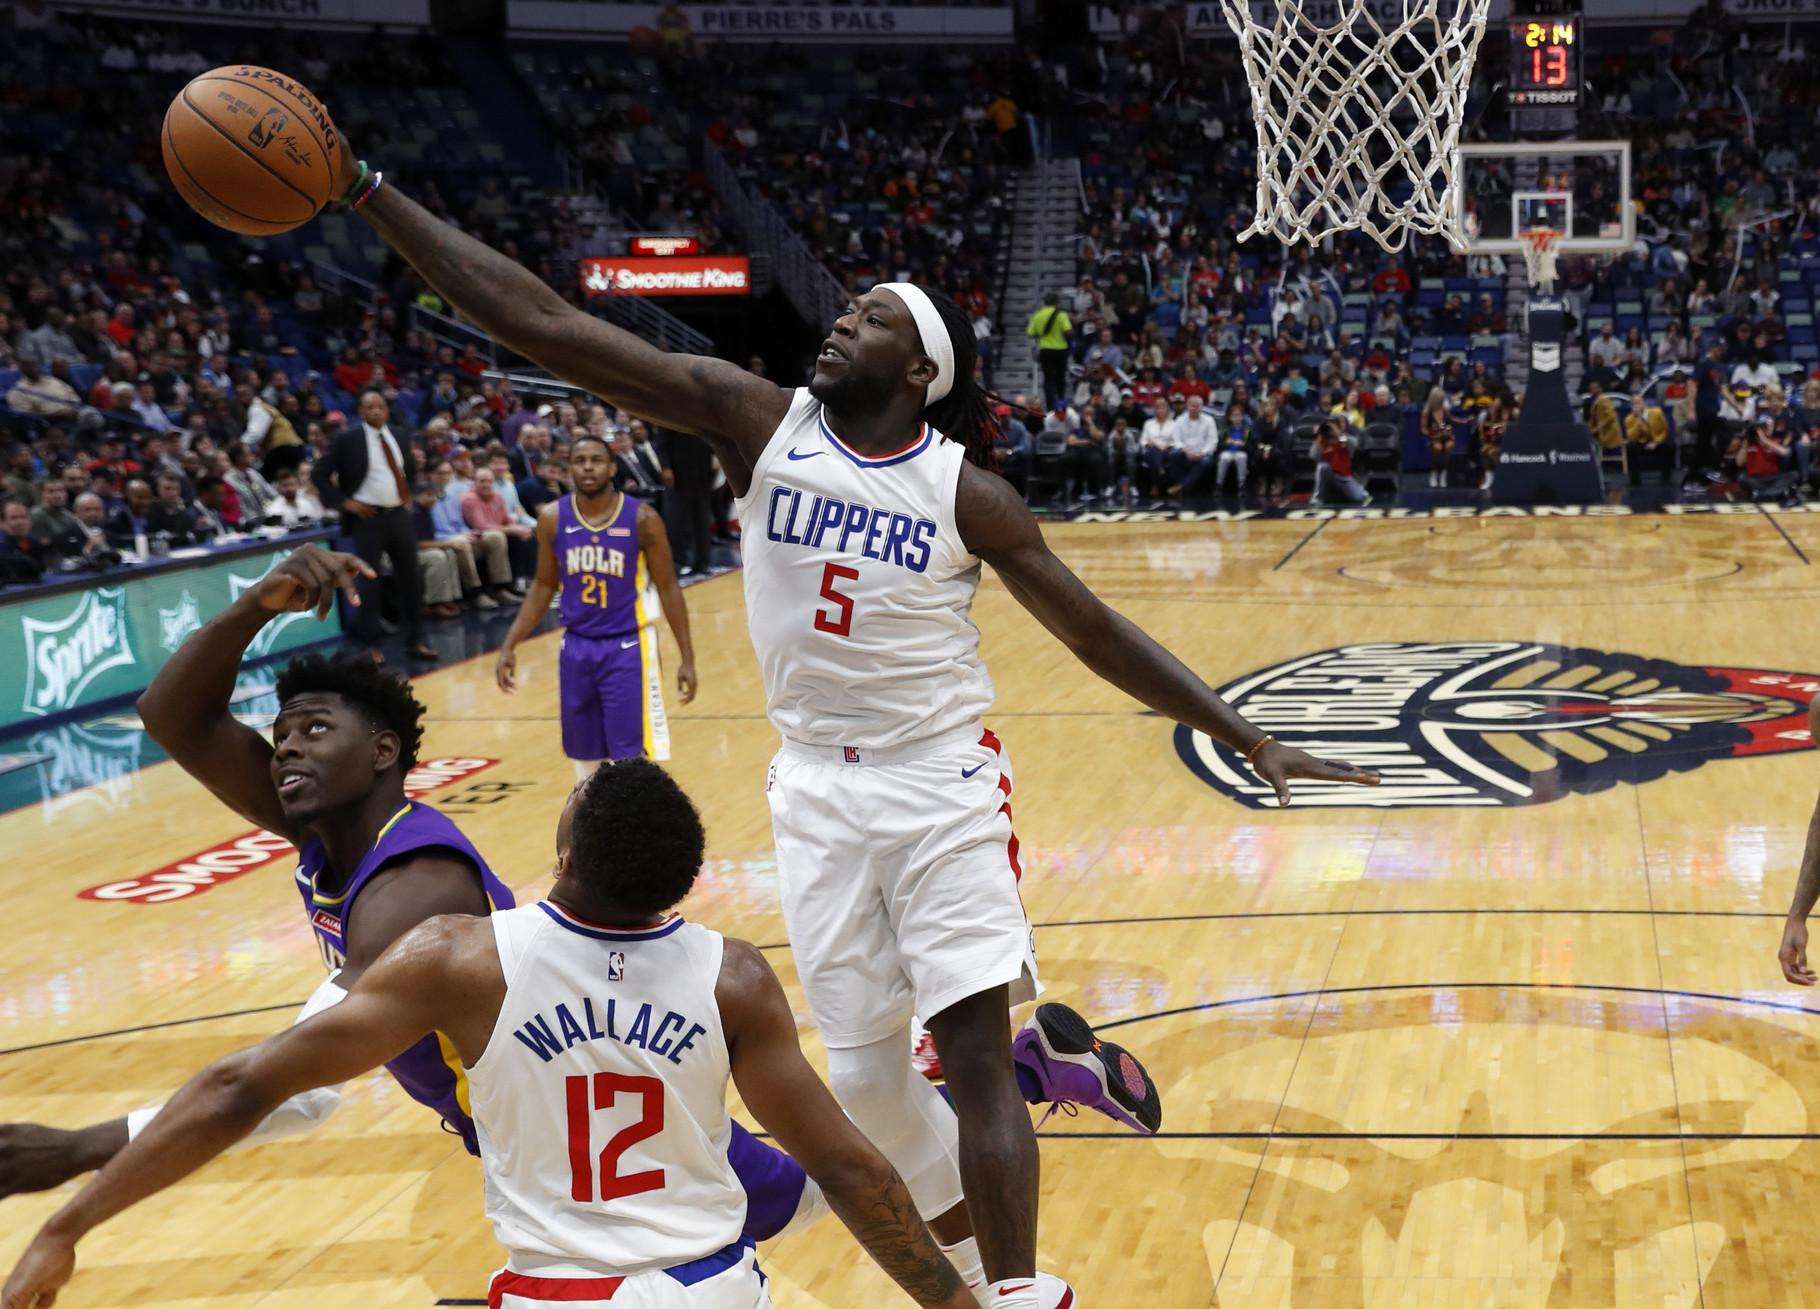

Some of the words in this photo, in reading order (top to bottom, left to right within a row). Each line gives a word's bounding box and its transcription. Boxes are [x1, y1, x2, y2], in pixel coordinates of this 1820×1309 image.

[702, 11, 822, 31] PIERRE'S
[831, 11, 897, 31] PALS
[1525, 22, 1573, 48] 2:14
[1532, 45, 1567, 85] 13
[235, 66, 338, 151] SPALDING
[1526, 90, 1578, 104] TISSOT
[615, 268, 702, 289] SMOOTHIE
[702, 266, 746, 288] KING
[767, 485, 937, 574] CLIPPERS
[1285, 505, 1633, 521] ORLEANS
[566, 545, 626, 578] NOLA
[581, 574, 608, 609] 21
[814, 561, 860, 637] 5
[36, 594, 117, 708] Sprite
[94, 831, 296, 903] SMOO
[513, 997, 707, 1065] WALLACE
[565, 1071, 666, 1203] 12
